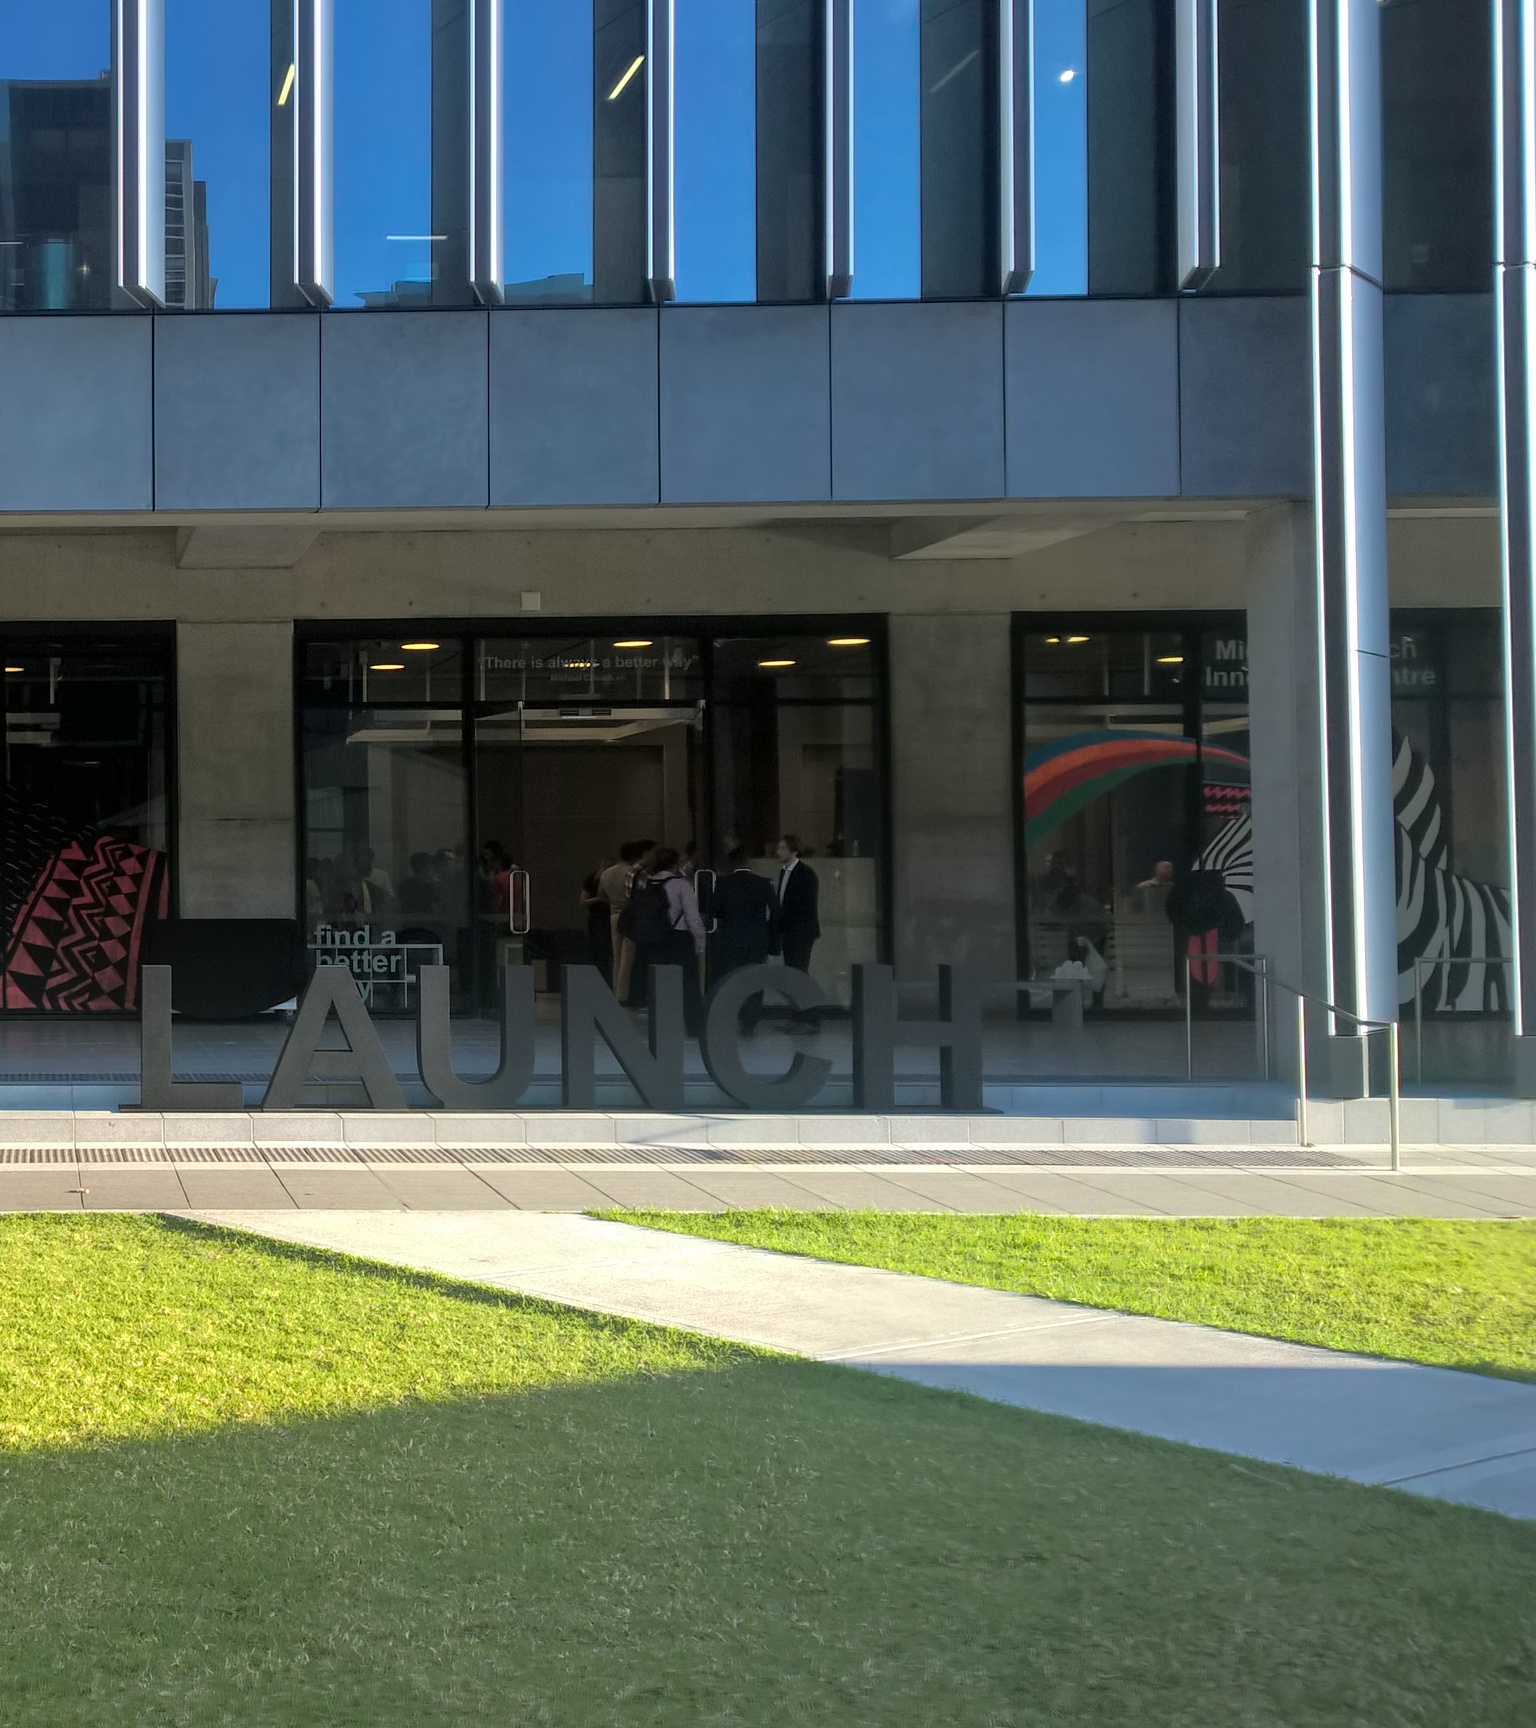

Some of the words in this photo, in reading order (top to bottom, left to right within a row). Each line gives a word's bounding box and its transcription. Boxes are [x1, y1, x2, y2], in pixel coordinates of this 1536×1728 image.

[531, 656, 543, 669] is
[602, 658, 611, 668] a
[616, 655, 659, 668] better
[314, 924, 370, 947] find
[381, 930, 397, 947] a
[315, 948, 401, 973] better
[141, 963, 983, 1113] LAUNCH
